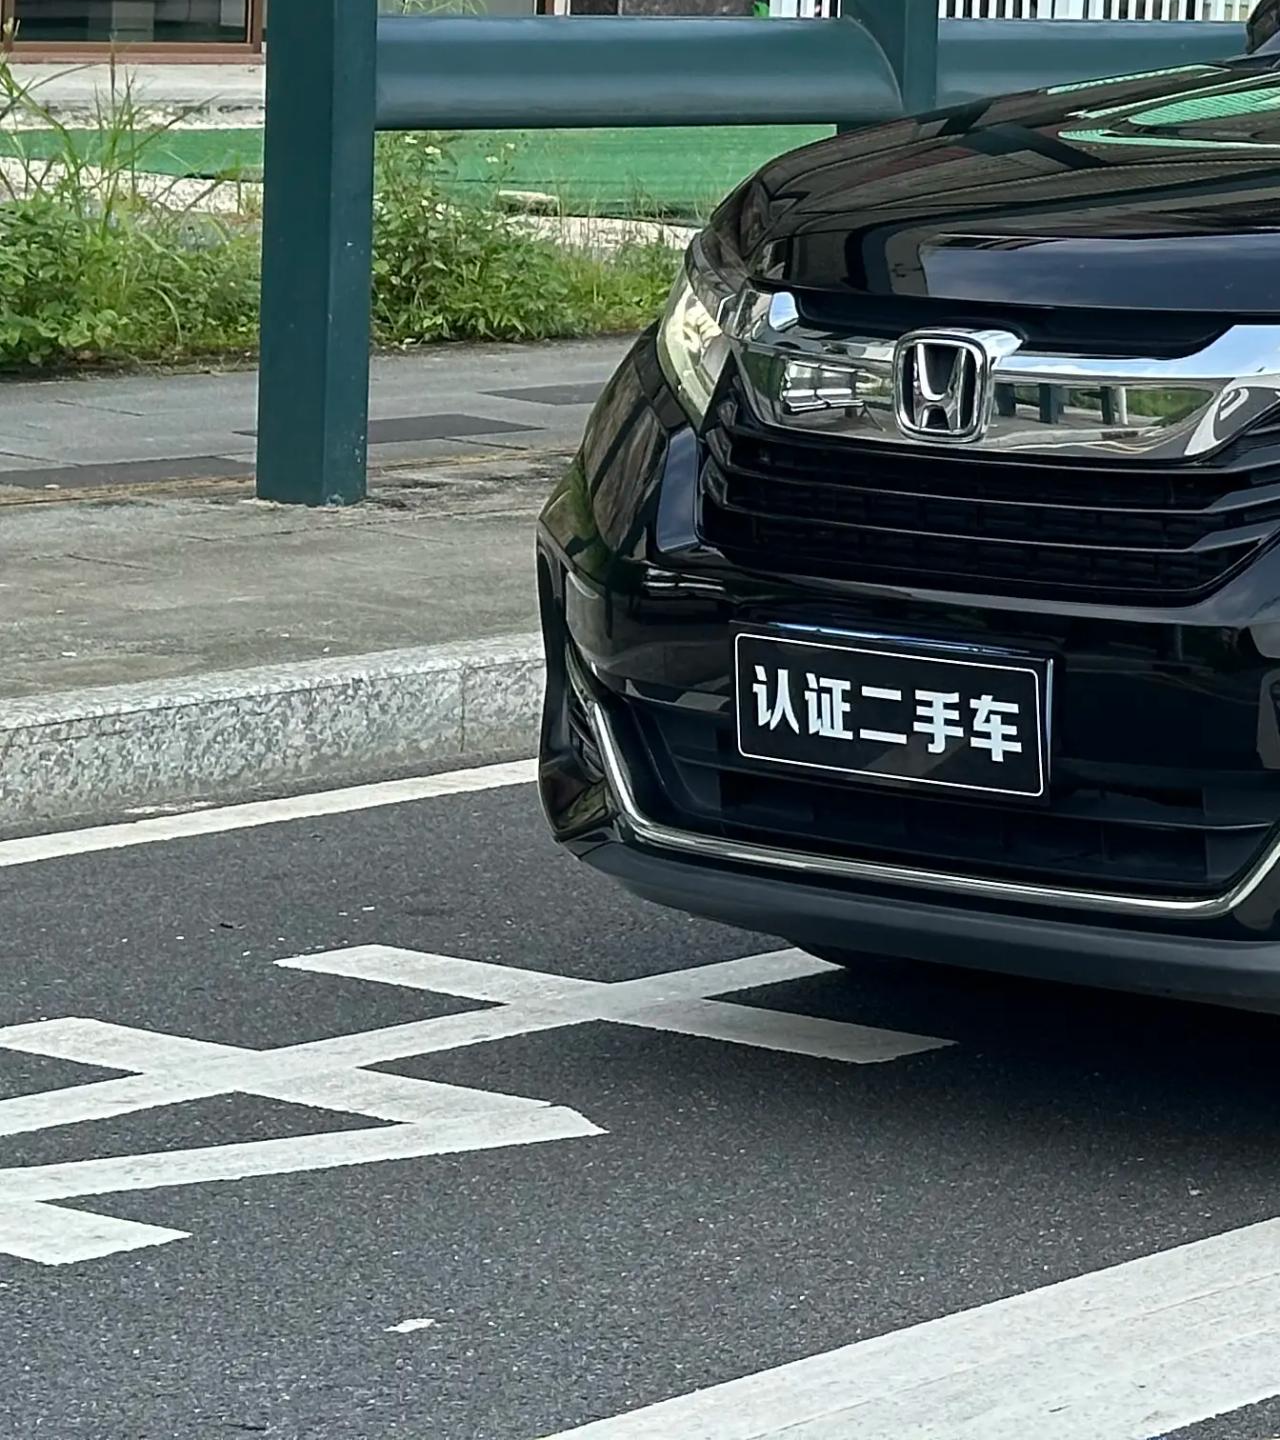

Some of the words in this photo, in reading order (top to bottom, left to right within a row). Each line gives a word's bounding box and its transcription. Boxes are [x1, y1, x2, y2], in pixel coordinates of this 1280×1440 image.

[752, 664, 1022, 762] 认证二手车
